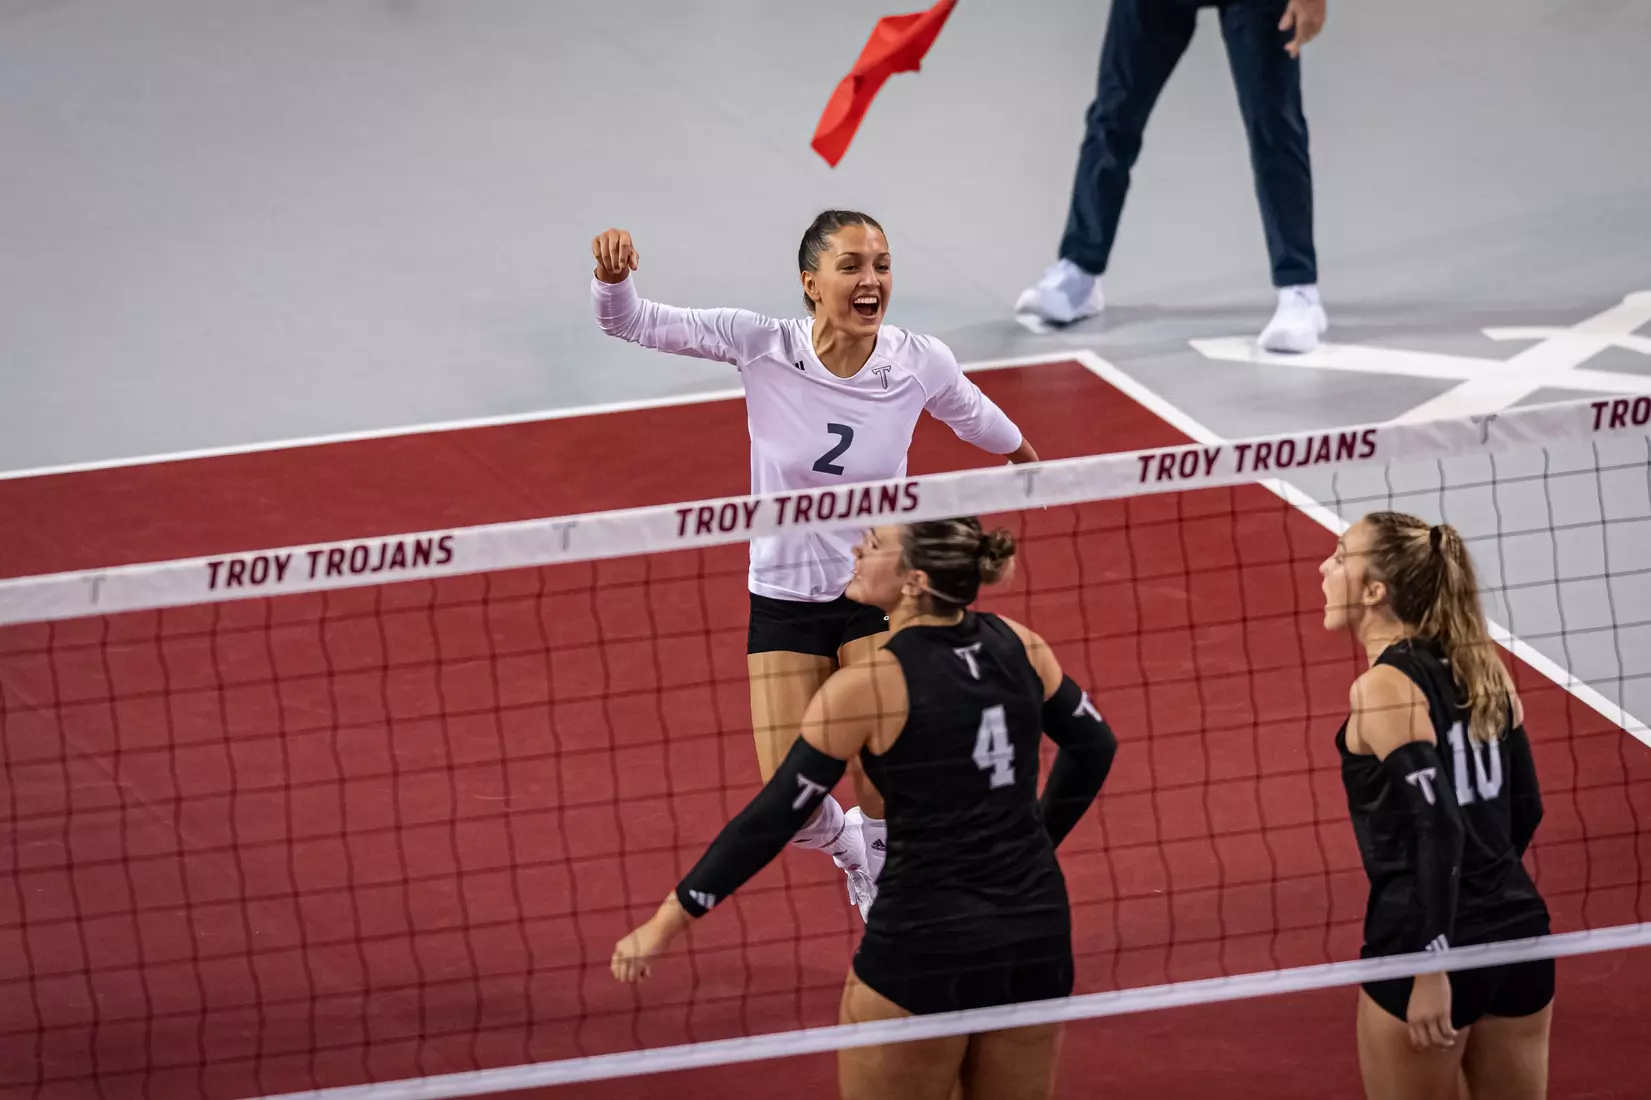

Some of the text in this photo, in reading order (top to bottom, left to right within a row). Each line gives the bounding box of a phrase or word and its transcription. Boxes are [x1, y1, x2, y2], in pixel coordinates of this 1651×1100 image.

[1590, 396, 1651, 431] TRO
[812, 423, 854, 476] 2
[1137, 428, 1378, 484] TROY TROJANS
[675, 481, 921, 537] TROY TROJANS
[206, 534, 456, 592] TROY TROJANS
[972, 704, 1015, 789] 4
[1447, 719, 1503, 806] 10
